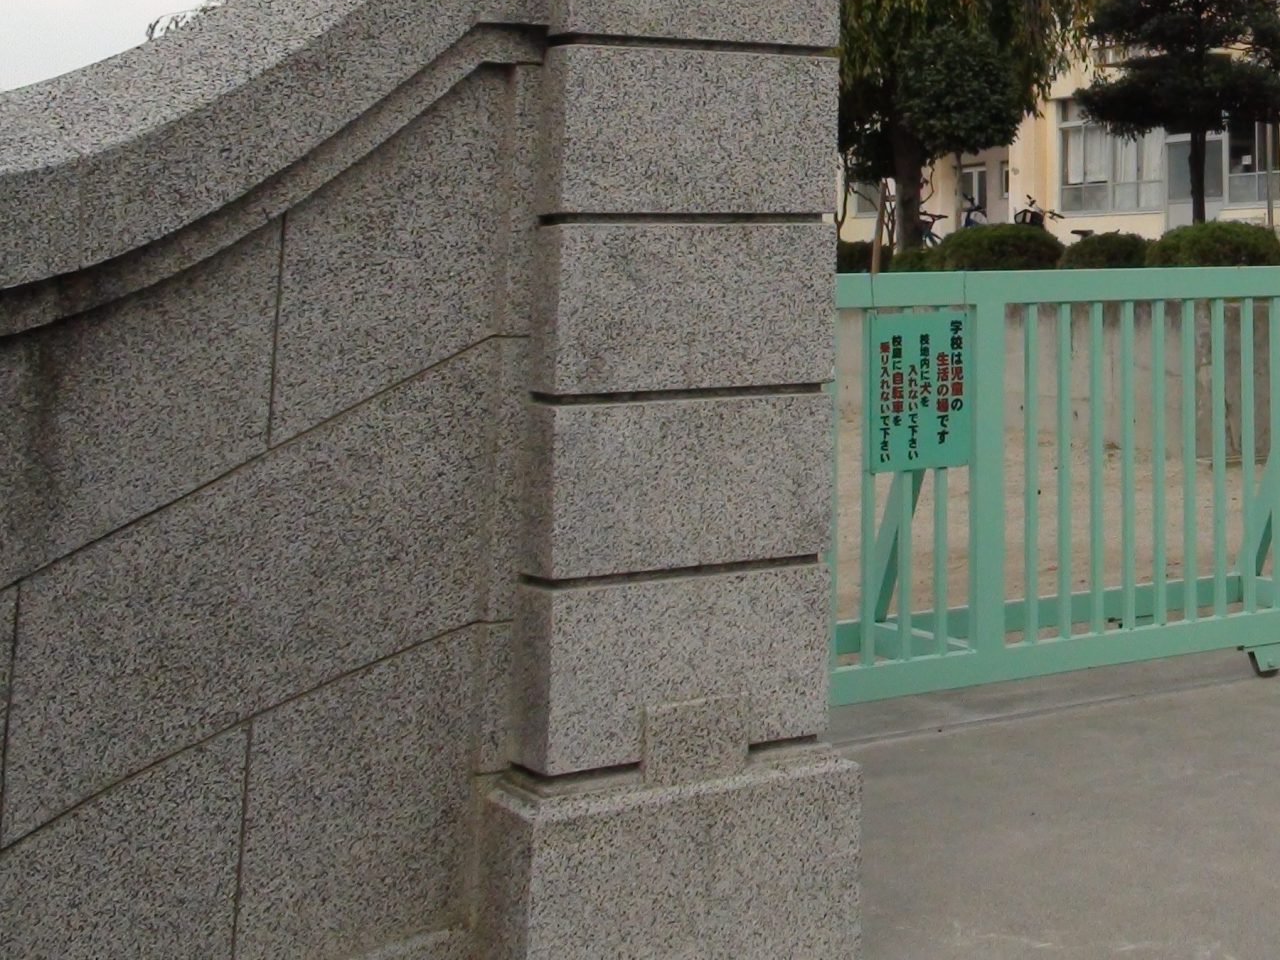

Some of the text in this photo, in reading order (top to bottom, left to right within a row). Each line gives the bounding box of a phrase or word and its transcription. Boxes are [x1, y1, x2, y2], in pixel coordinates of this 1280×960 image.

[880, 341, 891, 463] 乗り入れないで下さい
[892, 335, 904, 427] 校庭に自転車を
[908, 364, 919, 460] 入れないで下さい
[936, 352, 950, 445] 生活の場です
[950, 320, 963, 411] 学校は児童の
